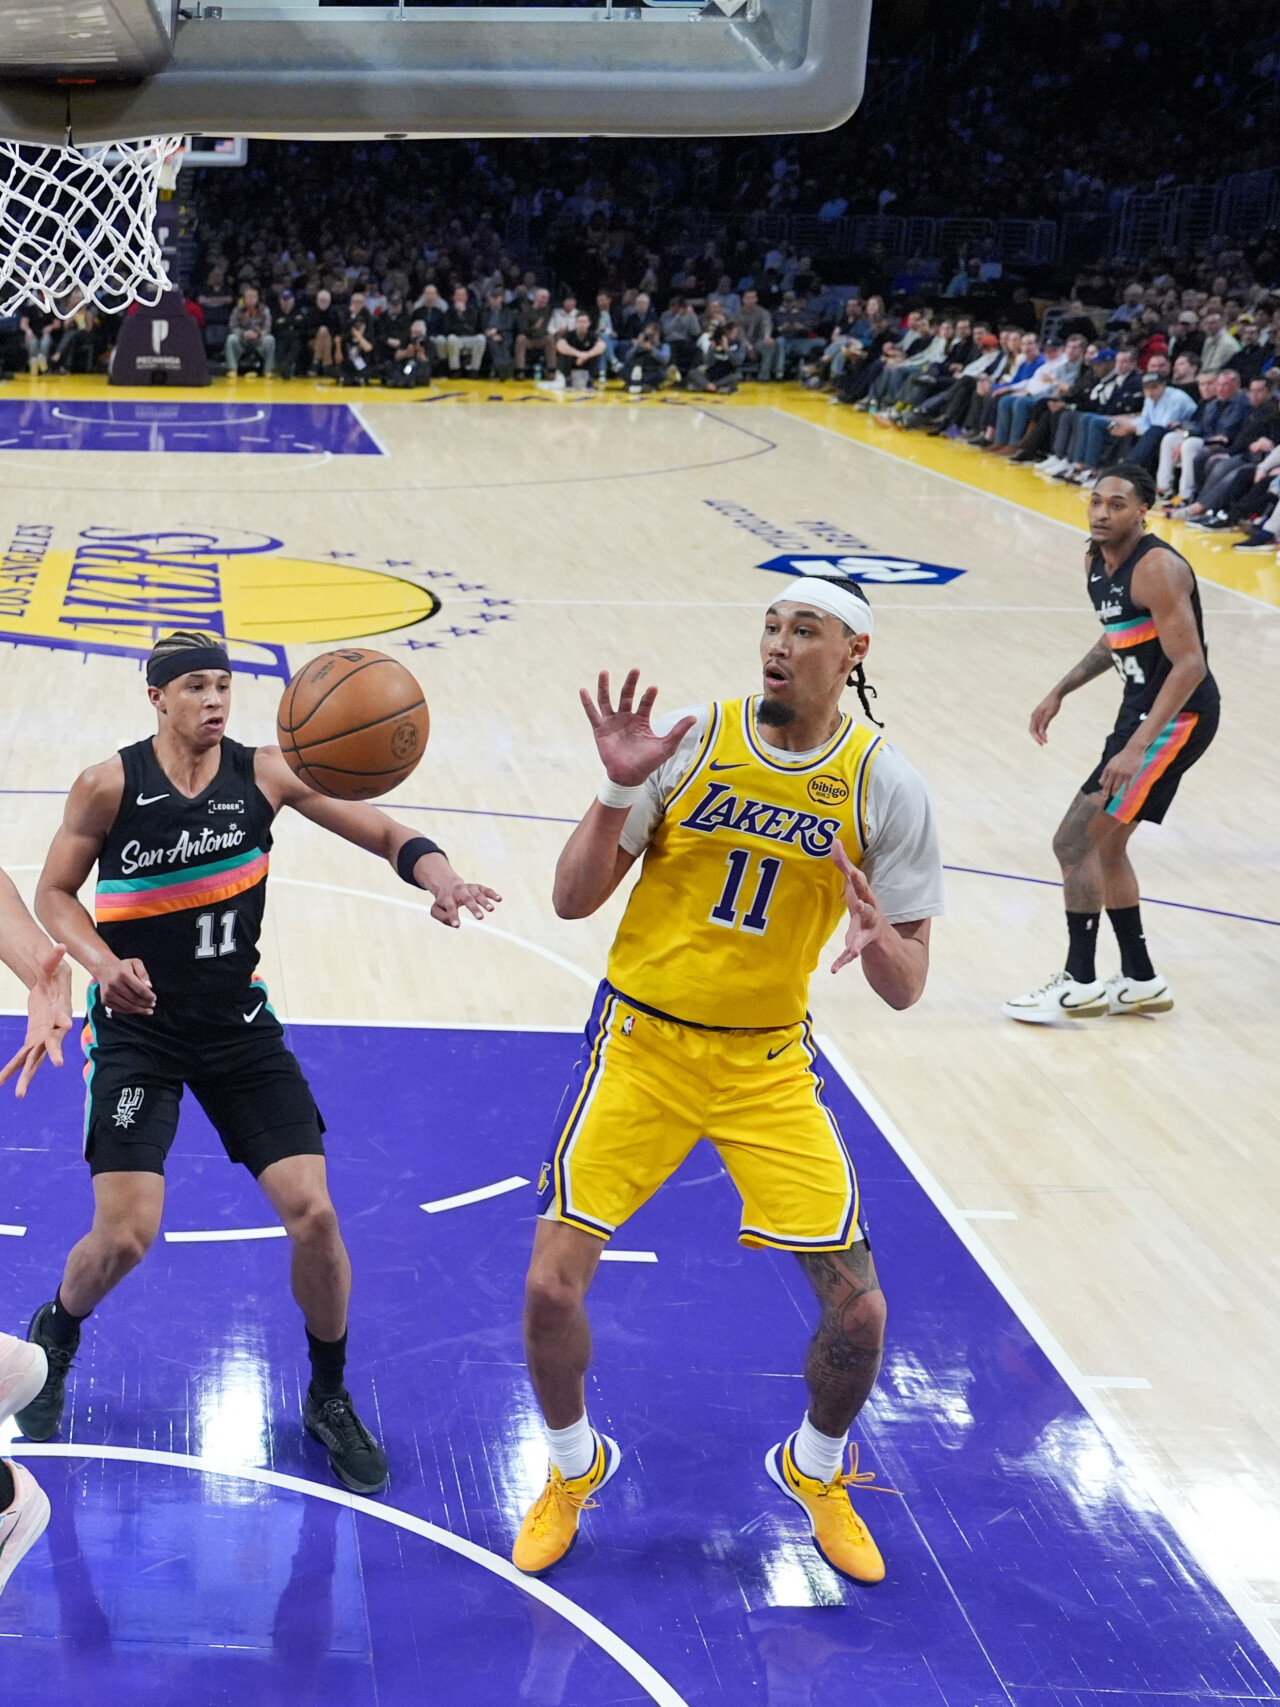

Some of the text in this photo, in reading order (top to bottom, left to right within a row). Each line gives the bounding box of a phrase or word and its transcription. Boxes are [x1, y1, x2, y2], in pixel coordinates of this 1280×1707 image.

[213, 803, 240, 811] LEDGER
[811, 780, 847, 798] bibigo
[679, 781, 843, 859] LAKERS
[121, 823, 246, 875] San Antonio
[707, 848, 783, 937] 11
[195, 910, 238, 959] 11
